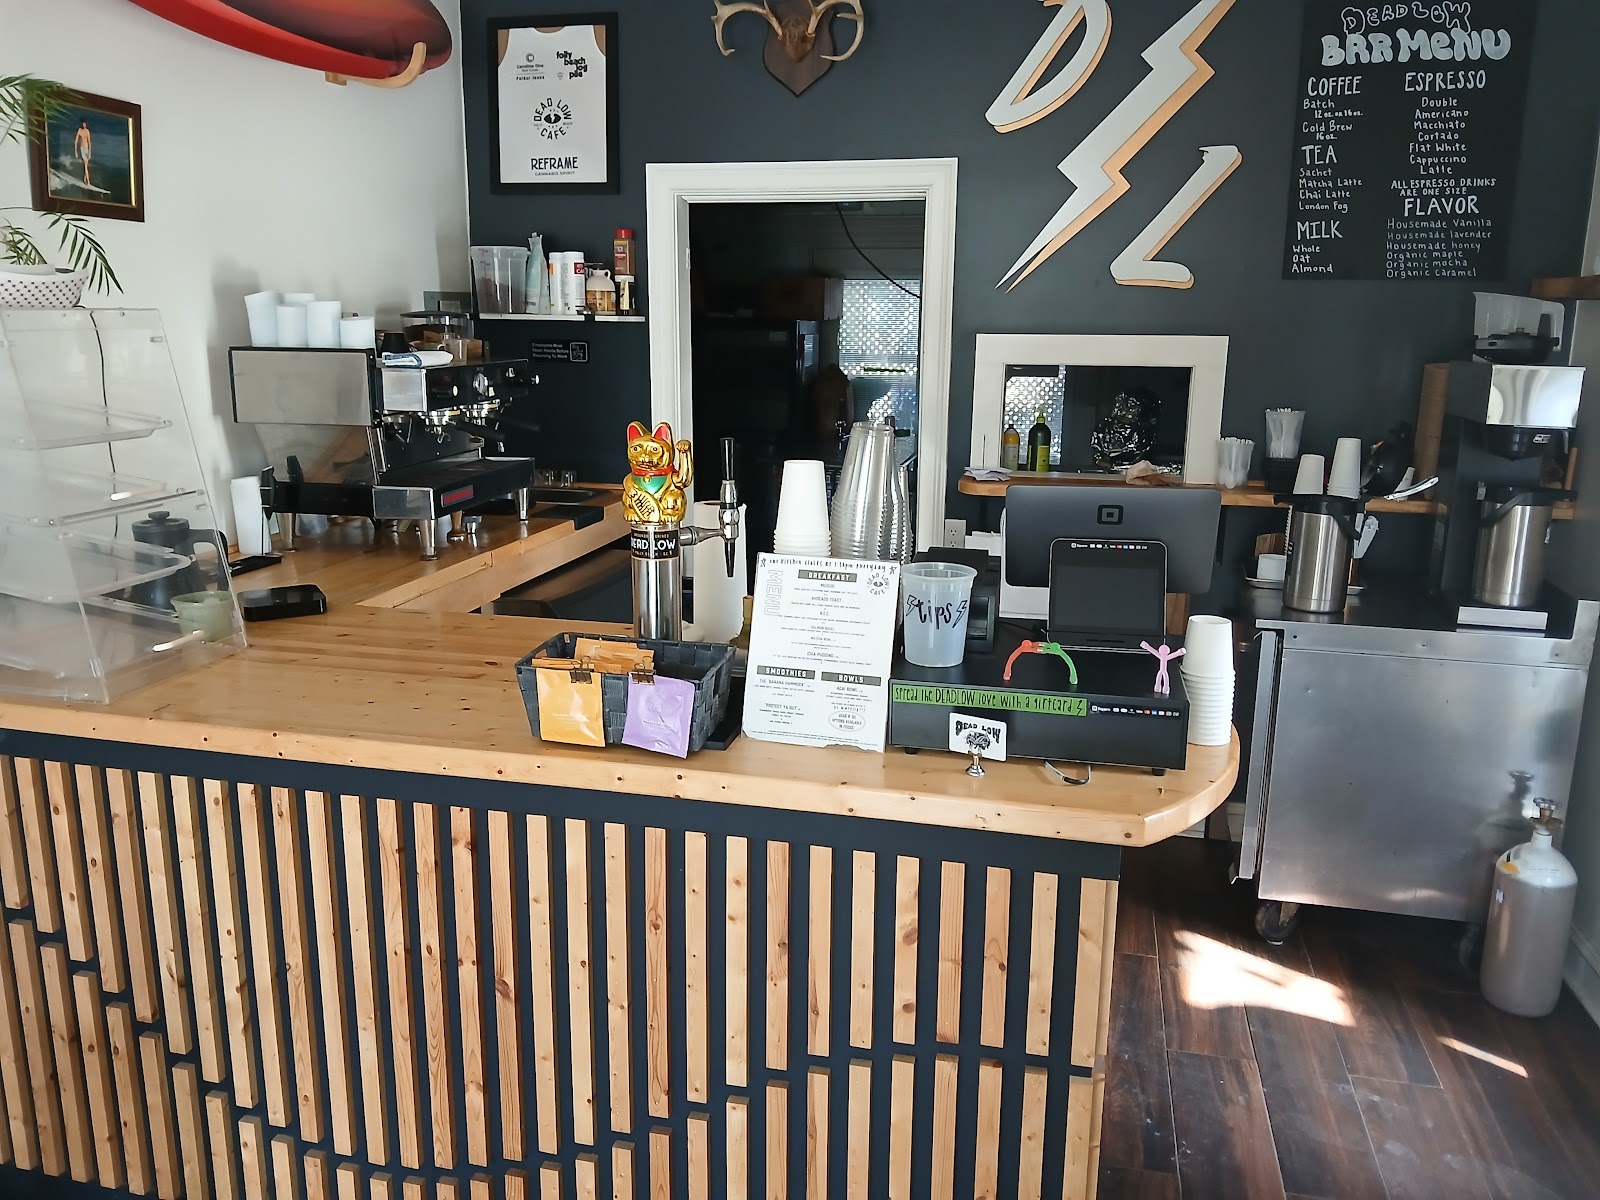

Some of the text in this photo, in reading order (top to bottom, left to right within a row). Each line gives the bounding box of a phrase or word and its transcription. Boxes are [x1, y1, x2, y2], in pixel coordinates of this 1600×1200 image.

[1341, 1, 1471, 35] DEAD LOW
[556, 51, 572, 59] folly
[564, 57, 585, 65] beach
[576, 64, 587, 72] log
[1405, 70, 1486, 91] ESPRESSO
[1308, 76, 1362, 96] COFFEE
[1304, 99, 1335, 109] Batch
[1421, 97, 1458, 107] Double
[534, 98, 572, 121] DEAD LOW
[1415, 109, 1469, 119] Americano
[1303, 120, 1352, 132] Cold Brew
[1414, 120, 1466, 130] Macchiato
[540, 127, 566, 140] CAFE
[1418, 132, 1459, 141] Cortado
[1410, 143, 1467, 152] Flat White
[1301, 145, 1337, 165] TEA
[531, 157, 578, 170] REFRAME
[1410, 155, 1466, 166] Cappuccino
[1299, 168, 1332, 176] Sachet
[1420, 165, 1452, 174] Latte
[1299, 178, 1362, 188] Matcha Latte
[1391, 178, 1496, 189] ALL ESPRESSO DRINKS
[1300, 190, 1350, 199] Chai Latte
[1299, 202, 1329, 210] London
[1404, 195, 1479, 216] FLAVOR
[1387, 218, 1447, 229] Housemade
[1297, 220, 1343, 240] MILK
[1387, 231, 1445, 240] Housemade
[1293, 244, 1320, 252] Whole
[1386, 241, 1480, 252] Housemade honey
[1293, 254, 1310, 263] Oat
[1387, 251, 1463, 262] Organic maple
[1292, 264, 1333, 273] Almond
[1386, 260, 1429, 270] Organic
[1387, 269, 1430, 279] Organic
[653, 539, 676, 550] LOW
[808, 572, 850, 581] BREAKFAST
[917, 599, 952, 630] tips
[766, 668, 806, 677] SMOOTHIES
[838, 675, 864, 683] BOWLS
[921, 689, 932, 702] the
[979, 692, 996, 706] love
[1026, 697, 1029, 708] a
[956, 720, 1001, 744] DEAD LOW
